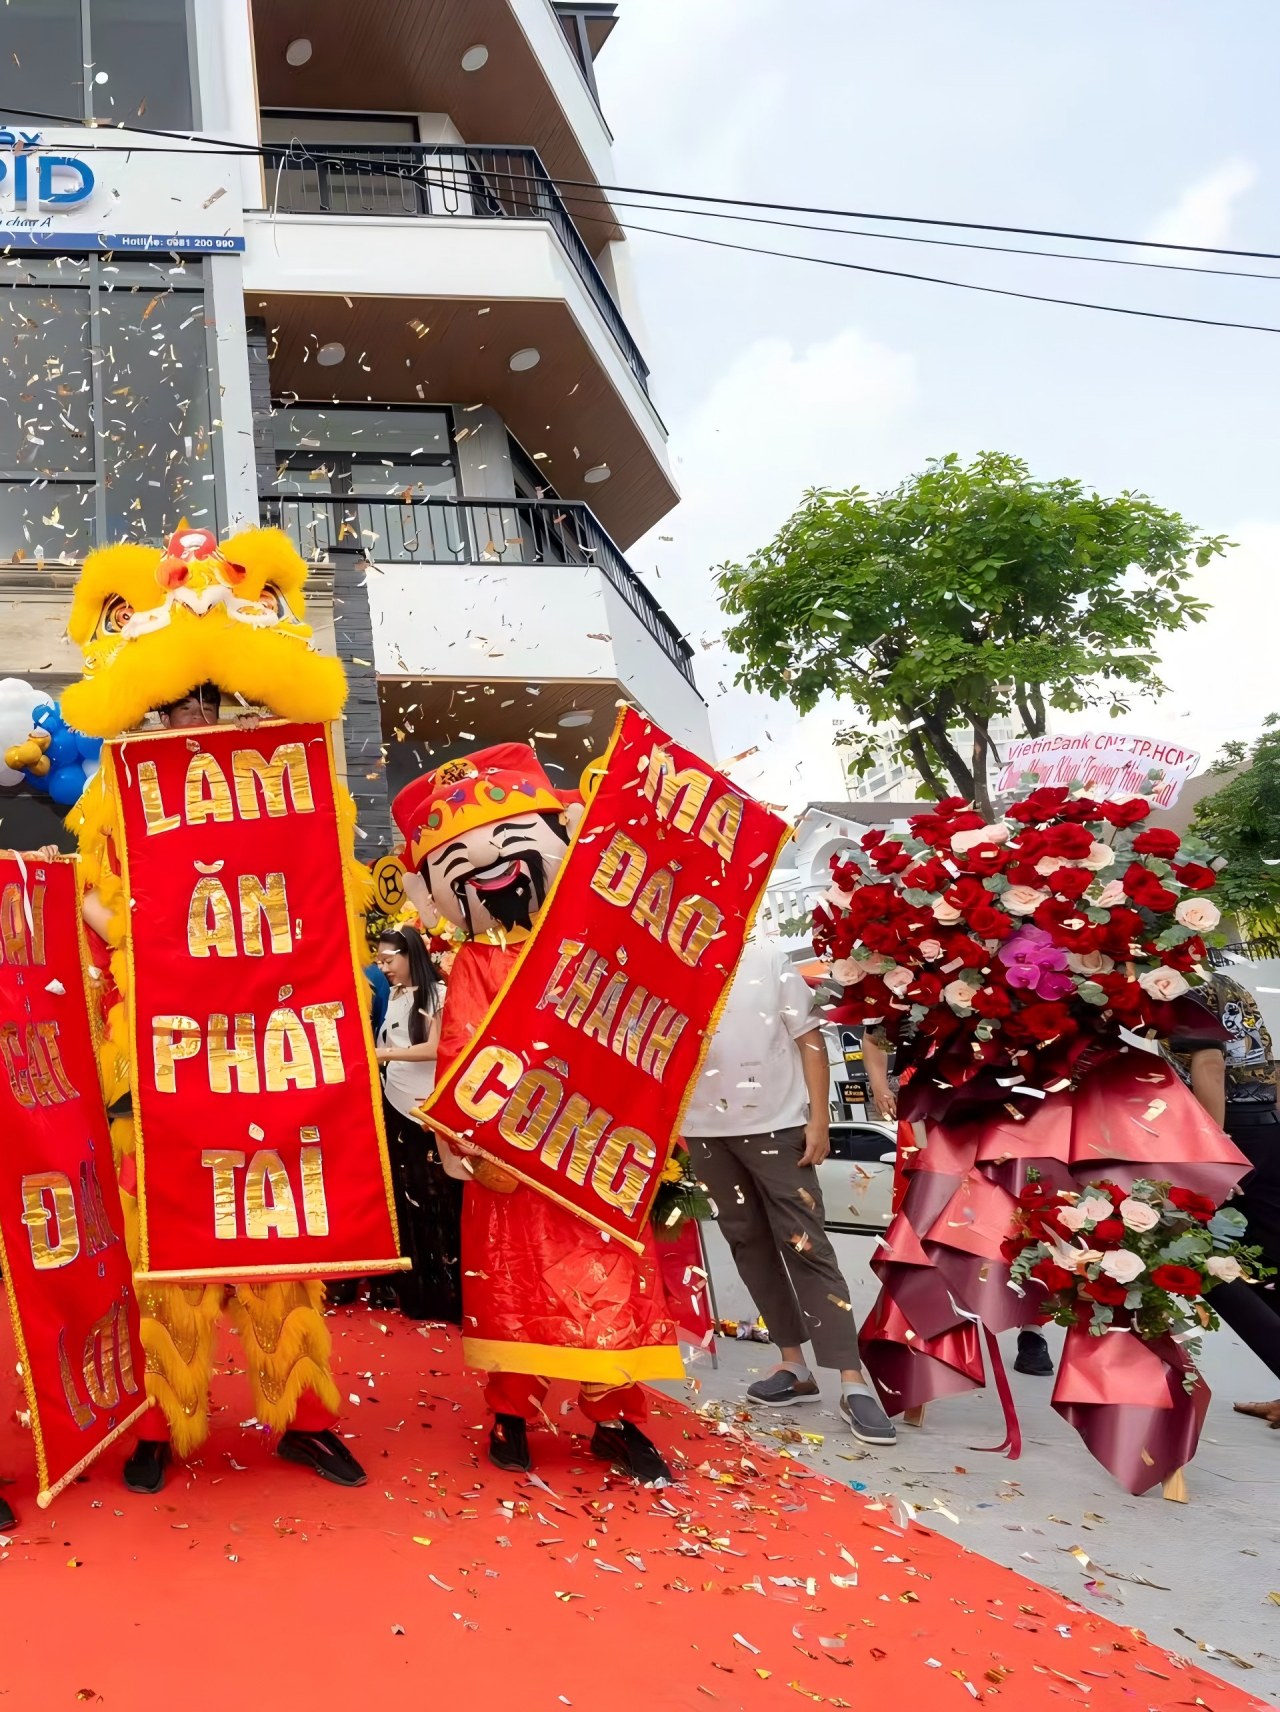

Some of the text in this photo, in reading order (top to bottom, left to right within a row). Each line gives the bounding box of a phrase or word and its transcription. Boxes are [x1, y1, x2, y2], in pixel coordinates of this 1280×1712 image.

[194, 238, 213, 247] 200
[137, 738, 315, 836] LÀM
[152, 984, 346, 1094] PHÁT
[535, 938, 690, 1084] THÀNH
[201, 1122, 329, 1239] TÀI
[454, 1045, 657, 1218] CÔNG
